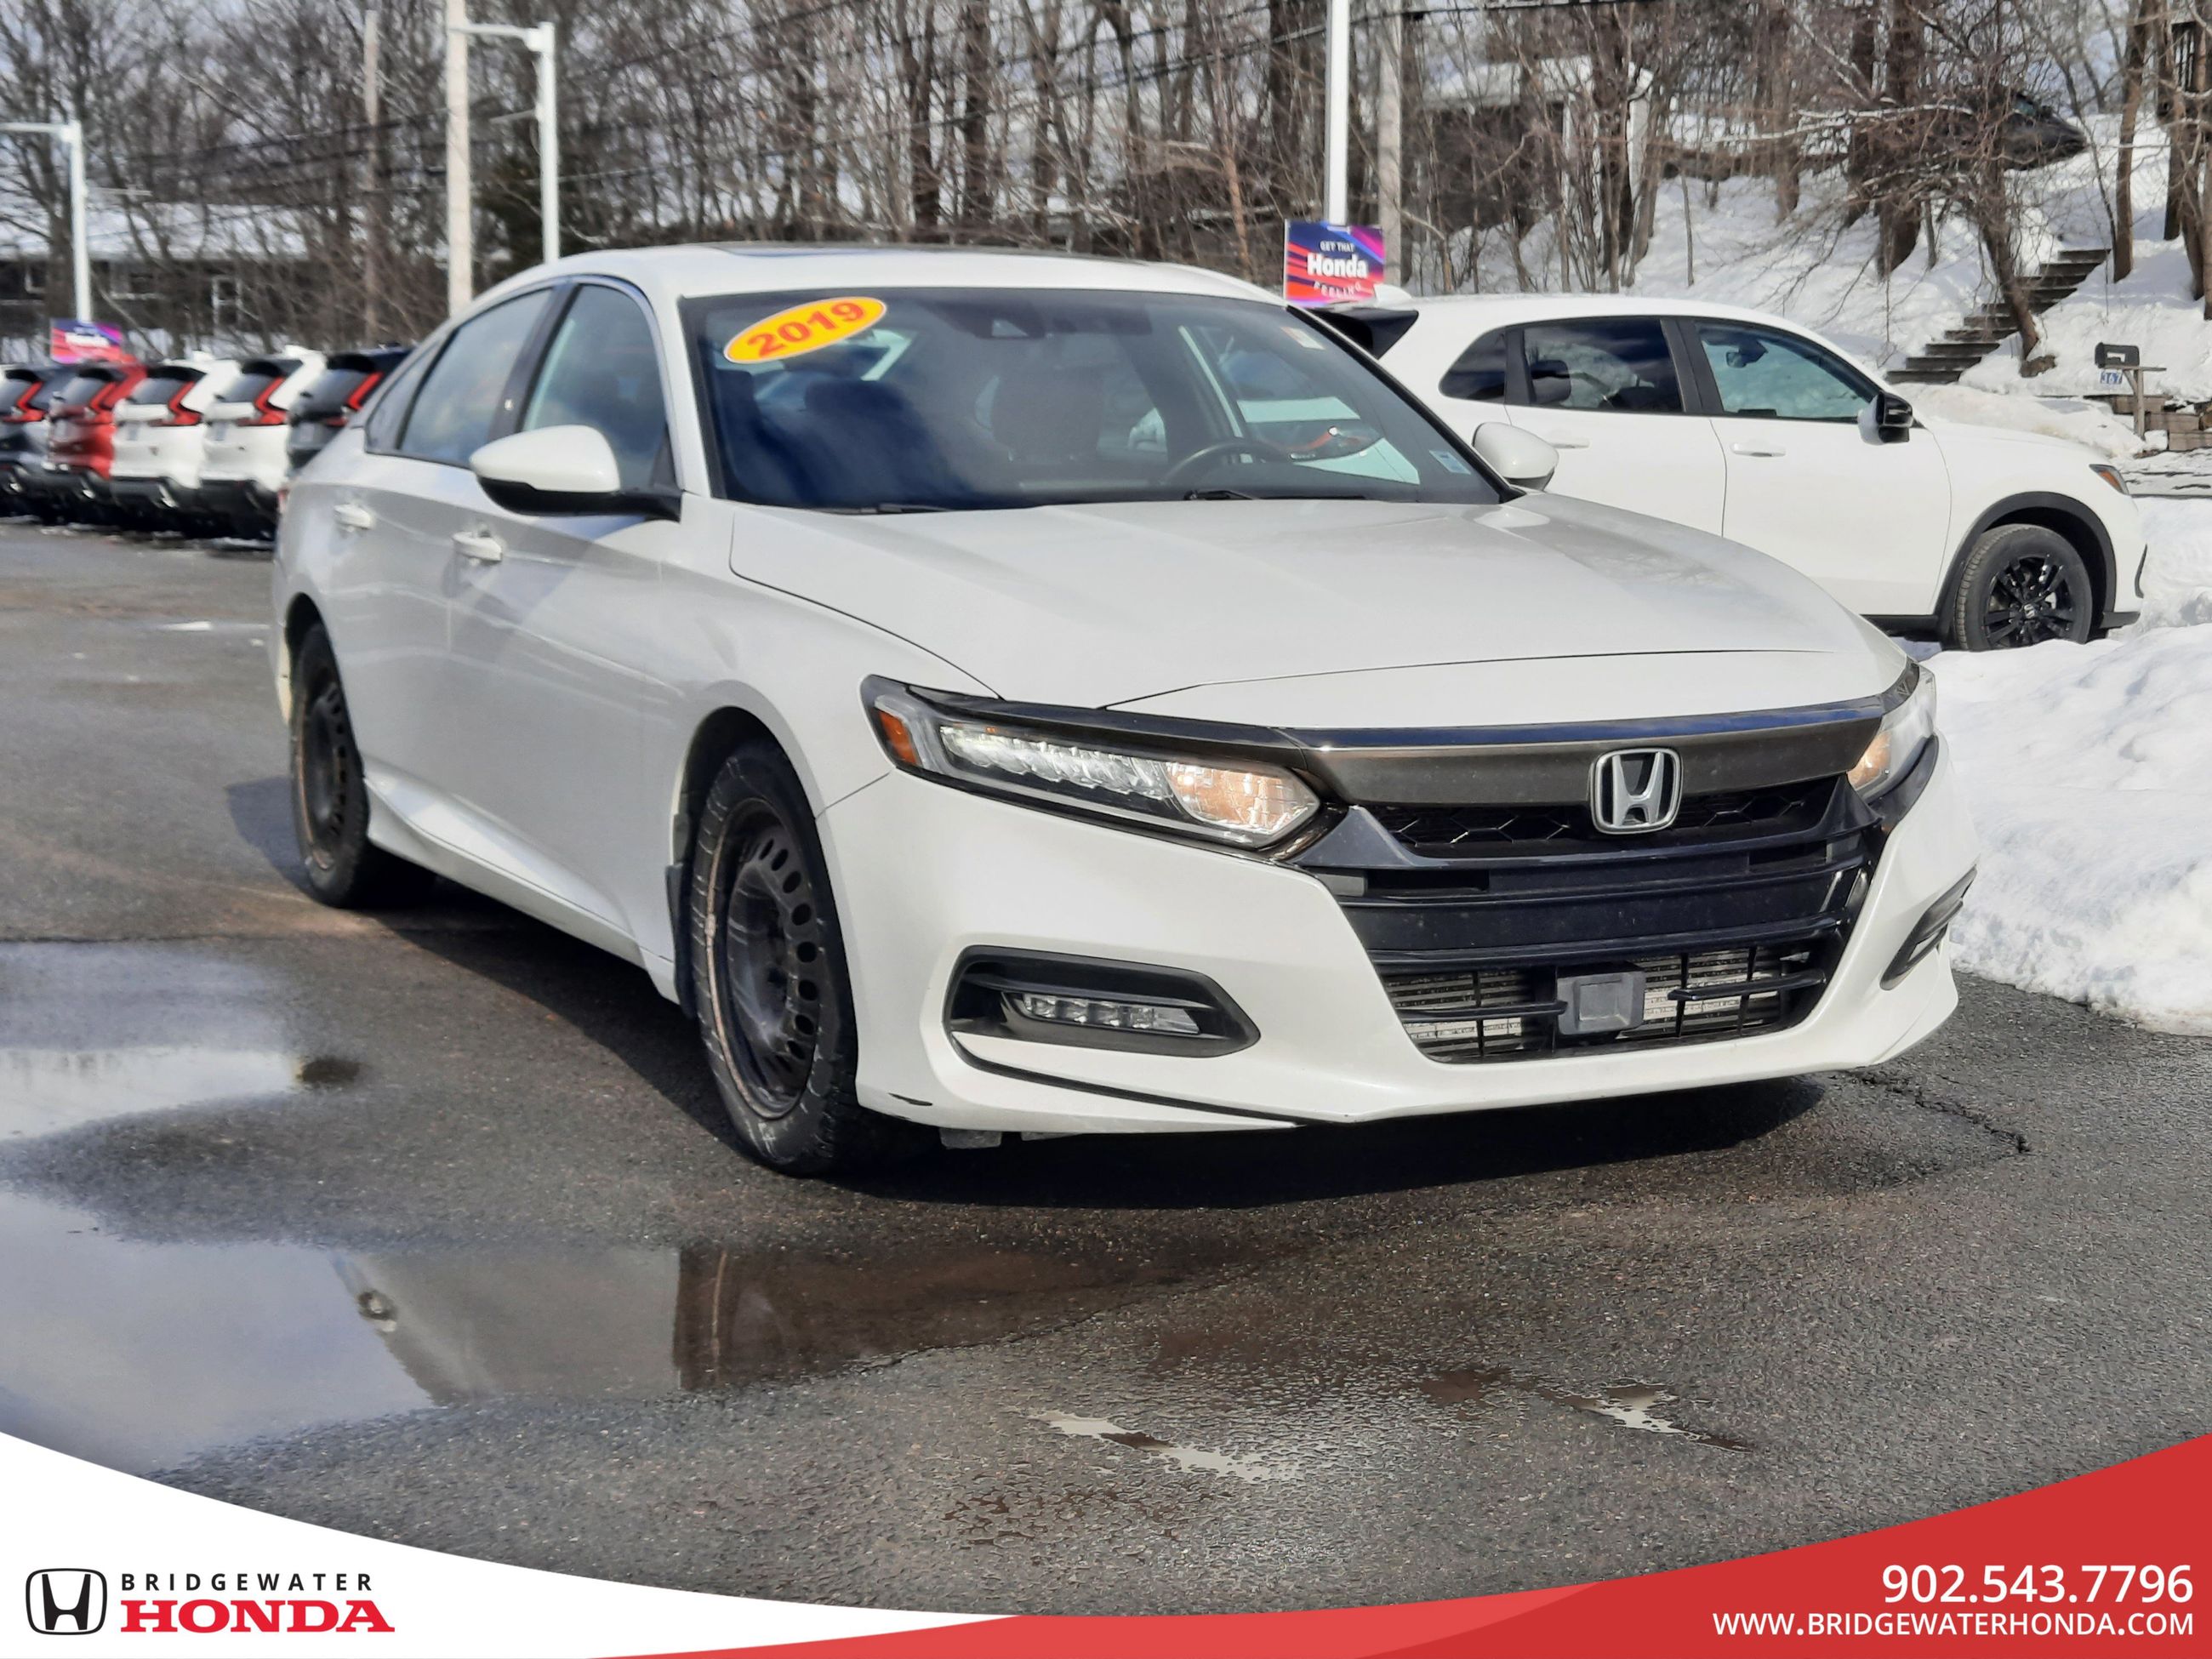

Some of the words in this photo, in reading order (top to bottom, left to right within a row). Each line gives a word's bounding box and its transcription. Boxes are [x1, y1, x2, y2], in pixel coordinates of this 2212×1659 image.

[1320, 241, 1336, 252] GET
[1337, 242, 1355, 253] THAT
[1307, 253, 1368, 279] Honda
[747, 301, 865, 358] 2019
